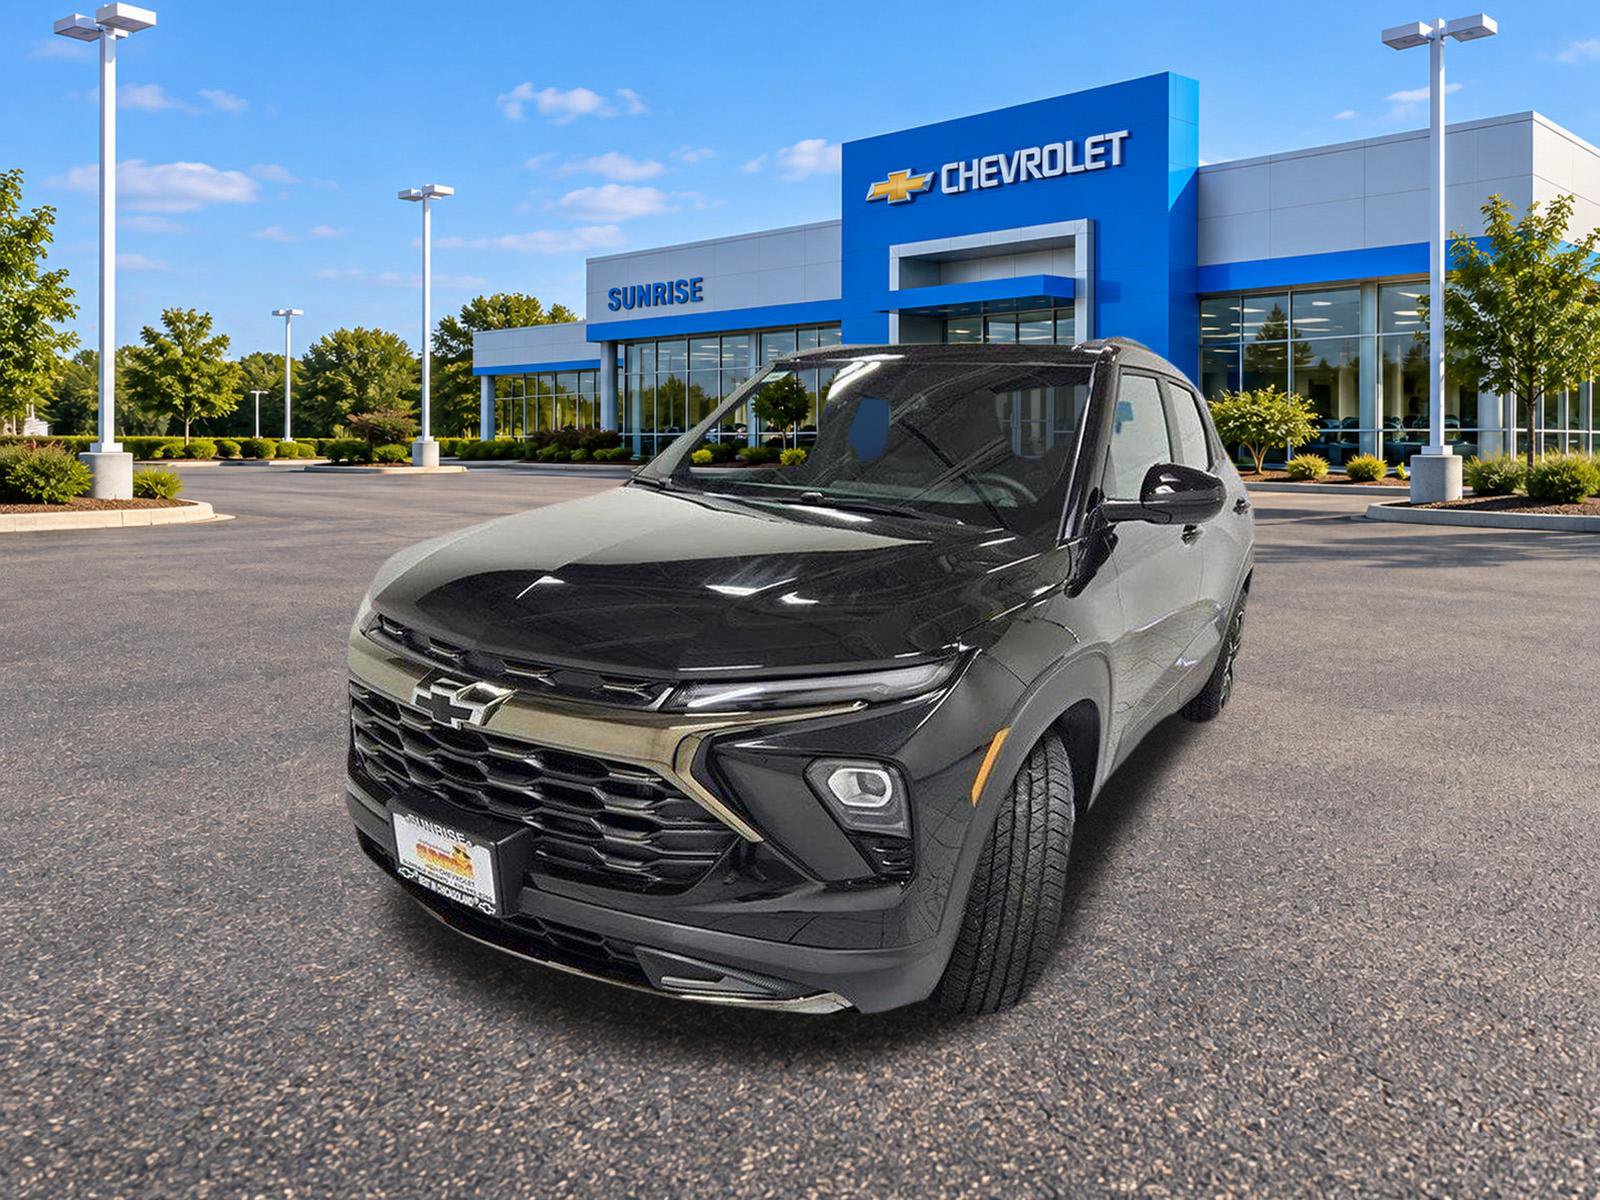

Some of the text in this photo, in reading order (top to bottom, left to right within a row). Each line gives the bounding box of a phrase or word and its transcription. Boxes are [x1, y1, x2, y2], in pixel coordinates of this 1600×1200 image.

[941, 130, 1129, 194] CHEVROLET
[608, 277, 704, 312] SUNRISE
[407, 813, 466, 843] SUNRISE
